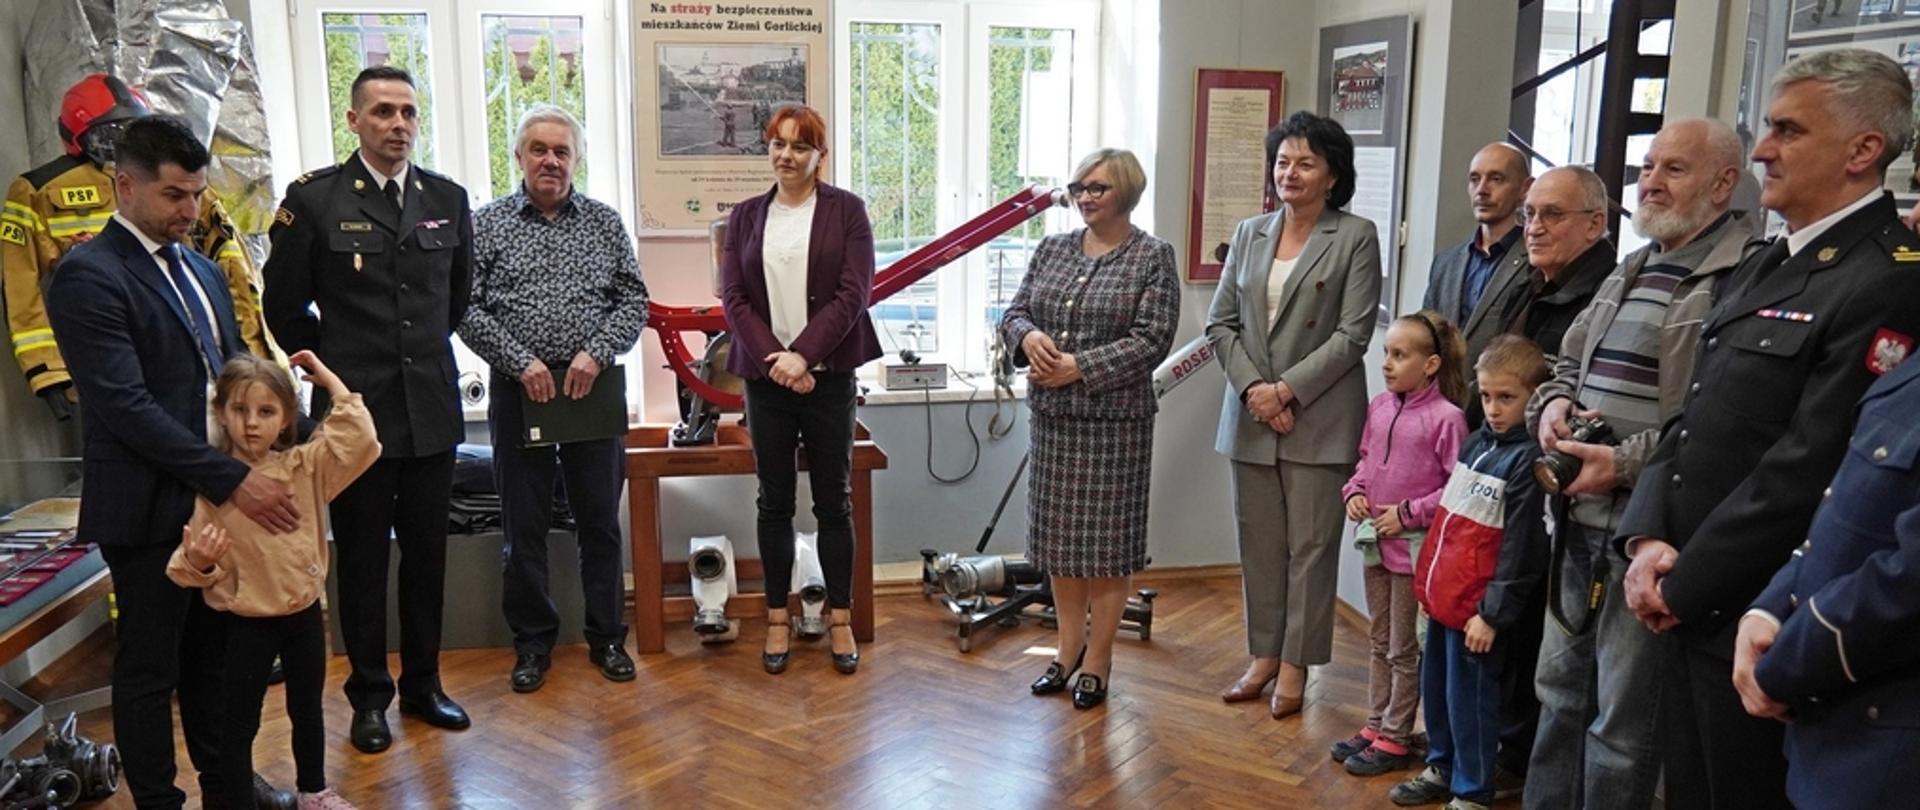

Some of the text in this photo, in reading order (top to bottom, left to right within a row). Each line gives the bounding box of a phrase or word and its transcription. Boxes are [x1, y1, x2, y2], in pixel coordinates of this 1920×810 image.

[650, 2, 813, 17] Na straży bezpieczeństwa
[641, 19, 823, 35] mieszkańców Ziemi Gorlickiej
[67, 190, 93, 202] PSP
